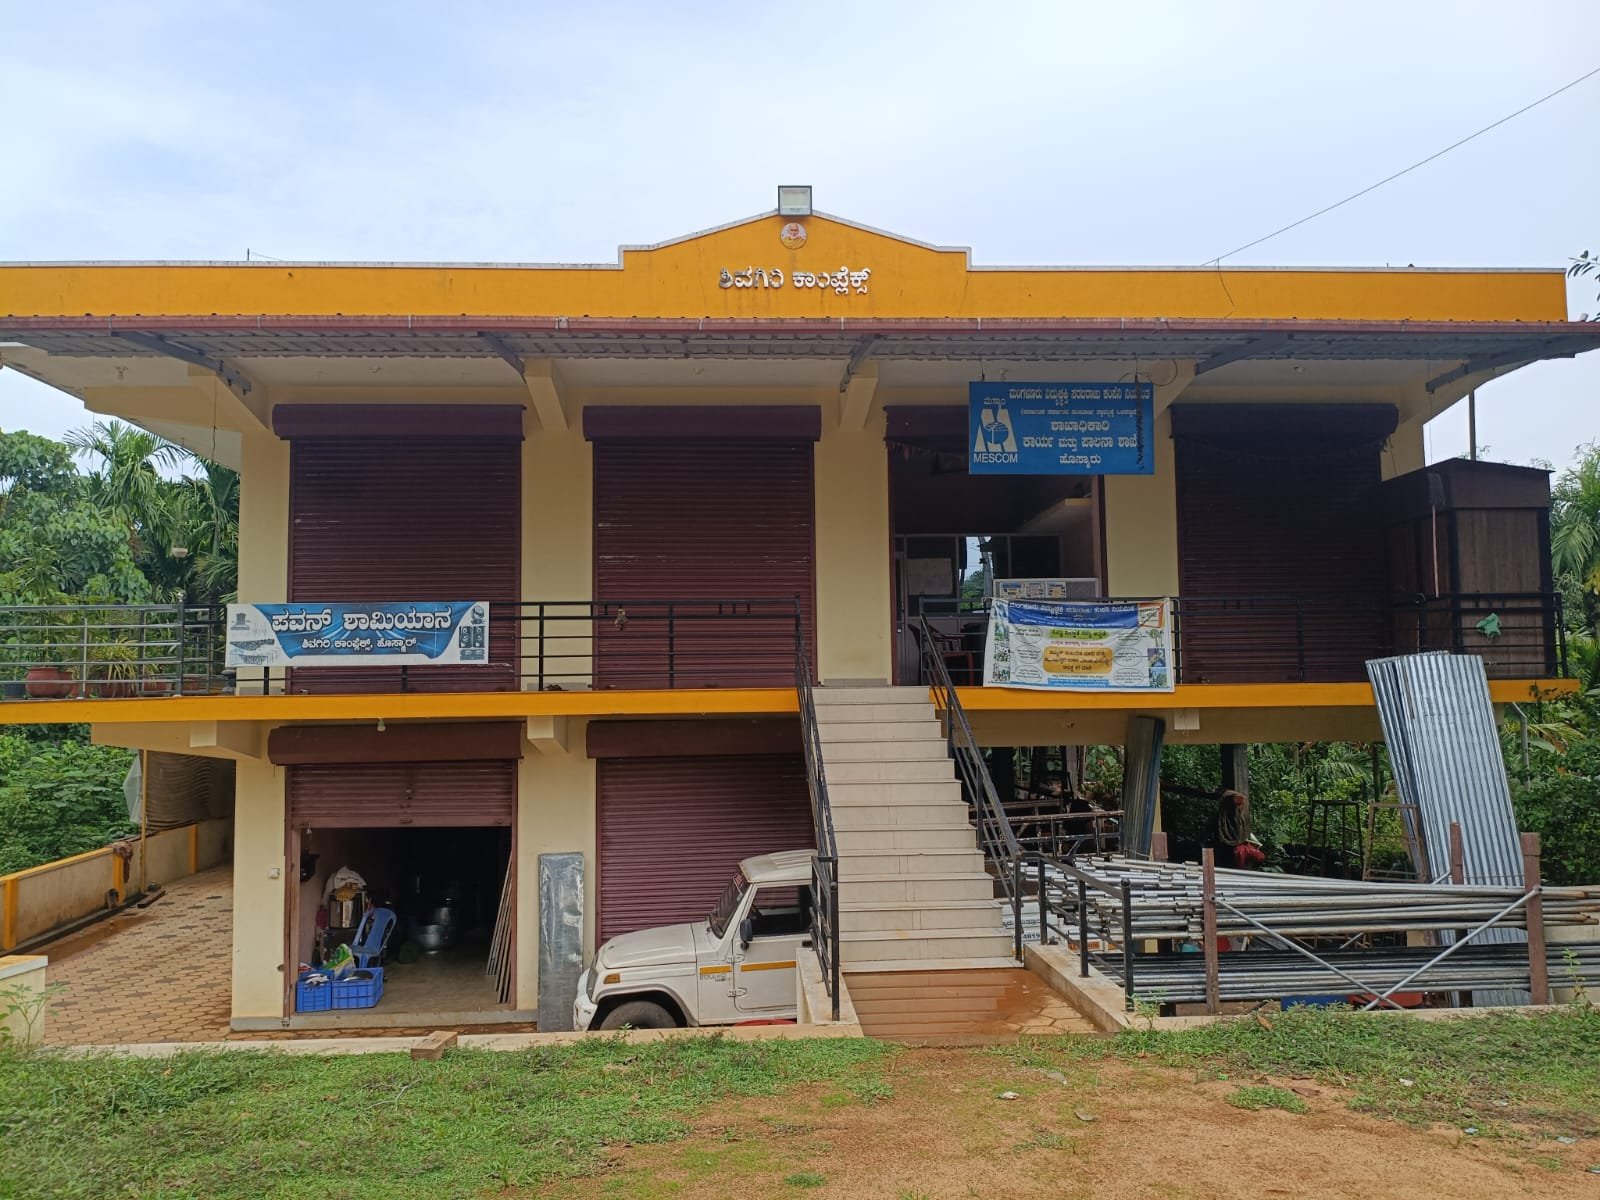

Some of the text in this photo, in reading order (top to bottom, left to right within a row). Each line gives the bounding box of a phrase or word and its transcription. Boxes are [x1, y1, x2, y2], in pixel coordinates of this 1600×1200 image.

[719, 265, 872, 295] ಶಿವಗಿರಿ ಕಾಂಪ್ಲೆಕ್ಸ್
[973, 453, 1018, 464] MESCOM
[271, 605, 452, 632] ಪವನ್ ಶಾಮಿಯಾನ
